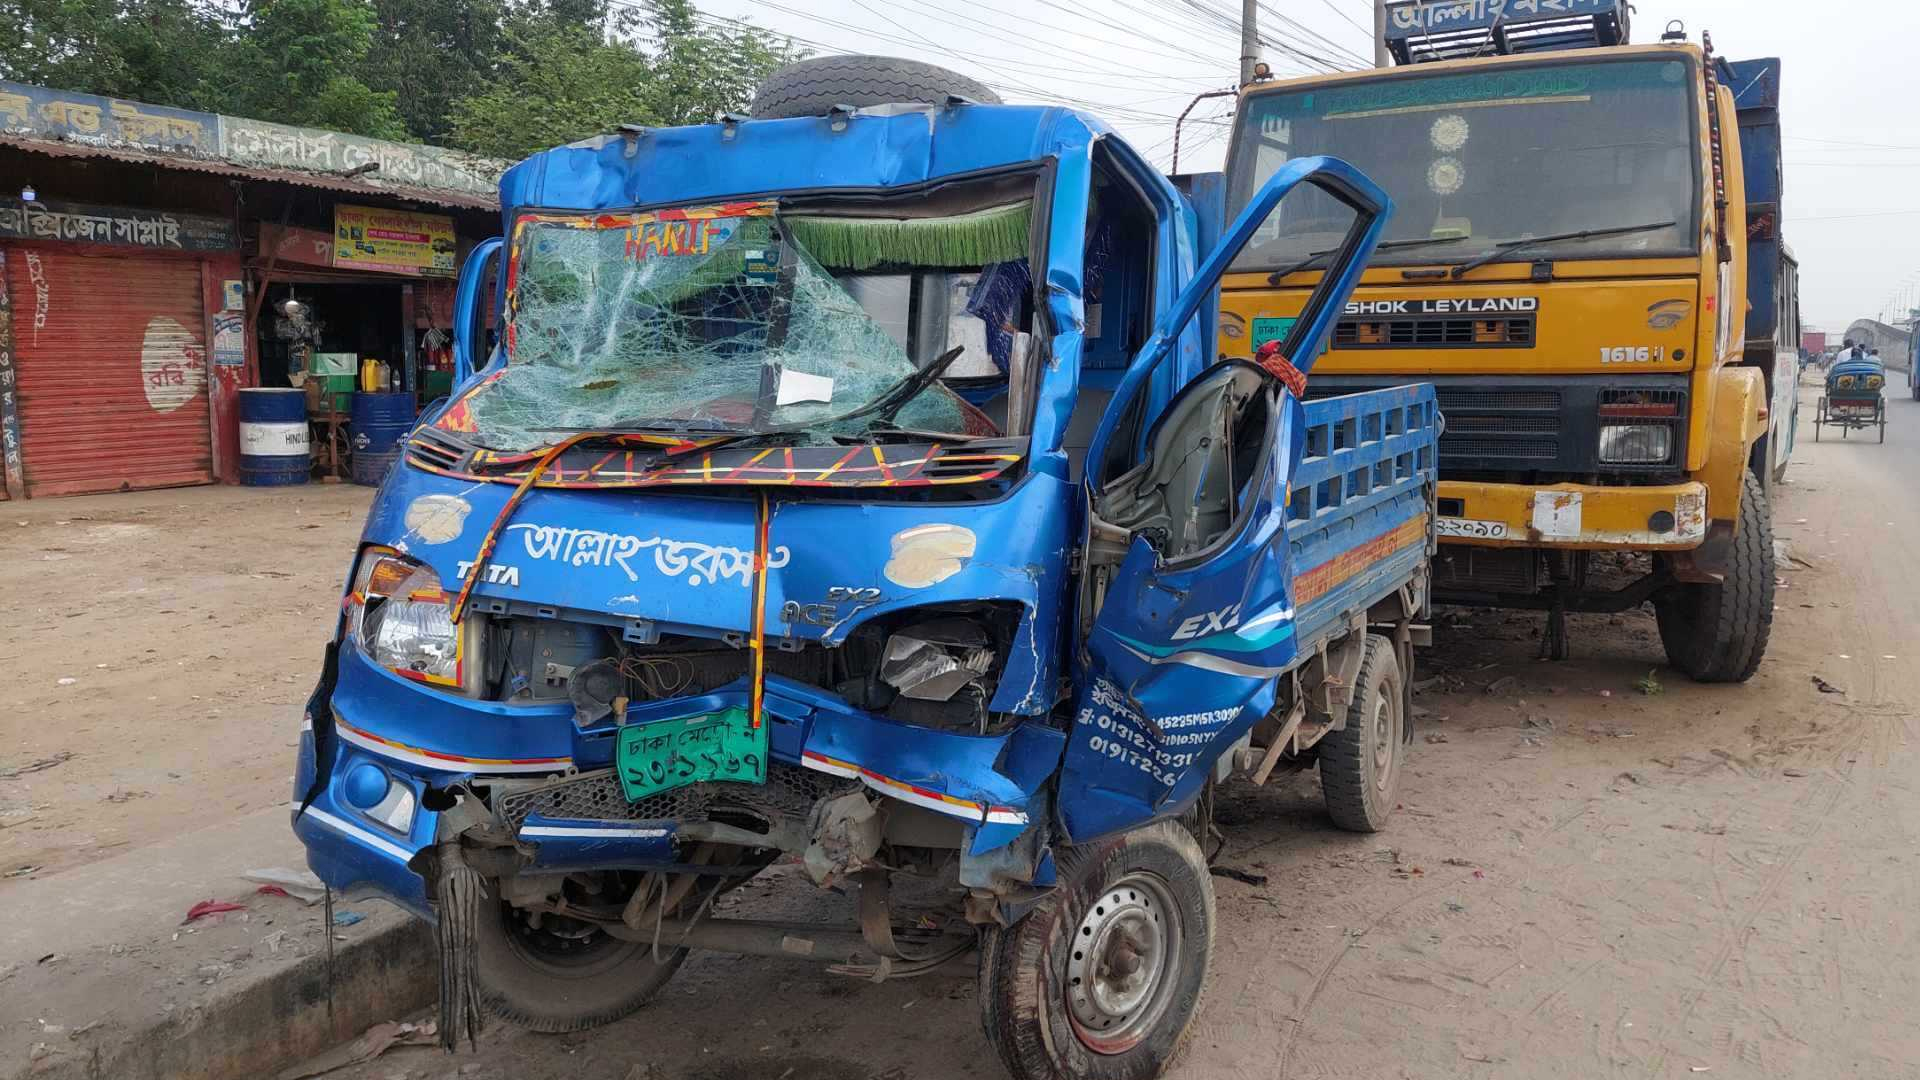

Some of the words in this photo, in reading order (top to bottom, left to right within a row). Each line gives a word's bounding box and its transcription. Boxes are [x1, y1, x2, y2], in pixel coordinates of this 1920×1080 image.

[624, 218, 721, 263] HANIF
[1342, 301, 1408, 314] SHOK
[1421, 297, 1536, 312] LEYLAND
[1600, 346, 1649, 362] 1616
[507, 522, 660, 581] আল্লাহ
[655, 539, 790, 587] ভরস
[829, 587, 880, 604] EX2
[783, 600, 837, 628] ACE
[627, 733, 672, 755] ঢাকা
